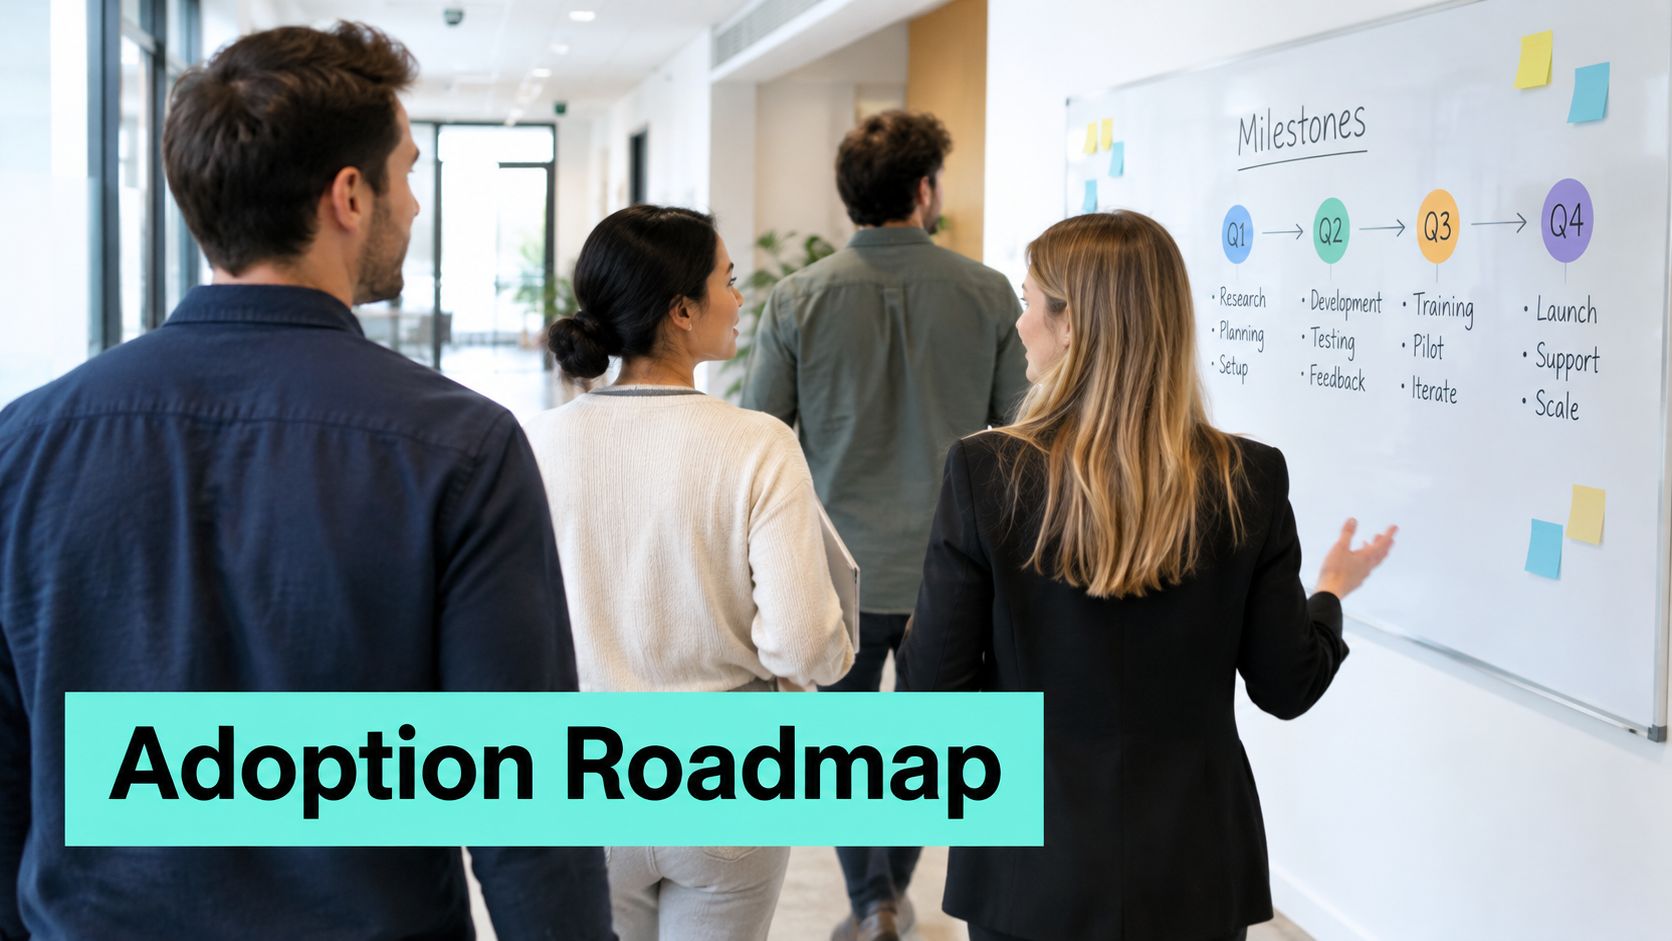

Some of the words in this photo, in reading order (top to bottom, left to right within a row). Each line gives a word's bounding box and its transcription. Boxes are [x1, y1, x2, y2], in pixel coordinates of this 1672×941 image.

[1238, 105, 1366, 156] Milestones
[1228, 222, 1244, 248] Q1
[1319, 217, 1342, 245] Q2
[1424, 211, 1451, 243] Q3
[1551, 203, 1584, 239] Q4
[1220, 286, 1266, 308] Research
[1311, 289, 1382, 321] Development
[1413, 292, 1473, 331] Training
[1537, 295, 1597, 324] Launch
[1220, 320, 1264, 353] Planning
[1310, 326, 1355, 361] Testing
[1414, 333, 1444, 360] Pilot
[1220, 354, 1248, 384] Setup
[1536, 341, 1600, 382] Support
[1310, 364, 1365, 392] Feedback
[1413, 375, 1457, 404] Iterate
[1536, 389, 1579, 421] Scale
